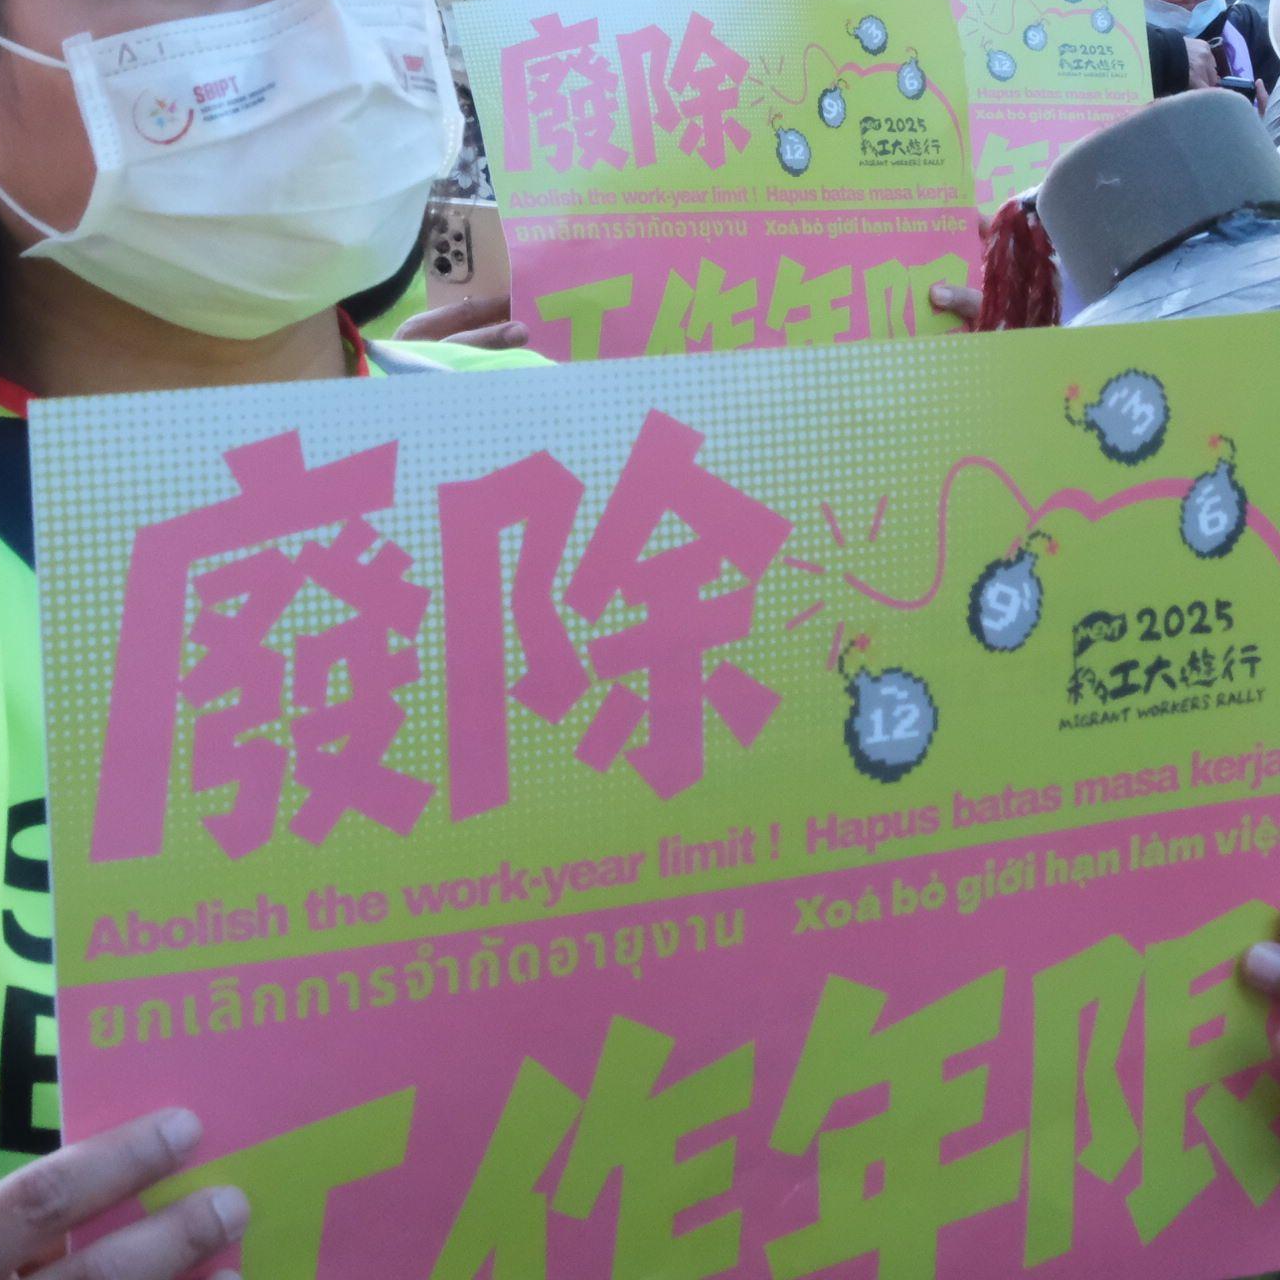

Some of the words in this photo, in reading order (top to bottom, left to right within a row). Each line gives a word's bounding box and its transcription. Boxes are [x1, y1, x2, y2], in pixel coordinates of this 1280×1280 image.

[1080, 44, 1114, 56] 2025
[500, 11, 751, 174] 廢除
[884, 117, 928, 133] 2025
[784, 143, 805, 160] 12
[509, 188, 583, 209] Abolish
[587, 187, 617, 206] the
[622, 186, 708, 208] work-year
[712, 185, 749, 204] limit
[766, 185, 817, 205] Hapus
[822, 185, 865, 202] batas
[869, 186, 913, 201] masa
[917, 184, 958, 203] kerja
[89, 407, 795, 865] 廢除
[1136, 598, 1235, 642] 2025
[864, 701, 919, 746] 12
[1058, 706, 1131, 732] MIGRANT
[1137, 694, 1212, 719] WORKERS
[1216, 687, 1266, 709] RALLY
[84, 893, 290, 963] Abolish
[304, 884, 390, 932] the
[401, 851, 646, 917] work-year
[658, 825, 757, 879] limit
[805, 802, 941, 856] Hapus
[951, 782, 1064, 830] batas
[1073, 759, 1180, 809] masa
[956, 852, 1036, 916] giới
[1044, 846, 1120, 889] hạn
